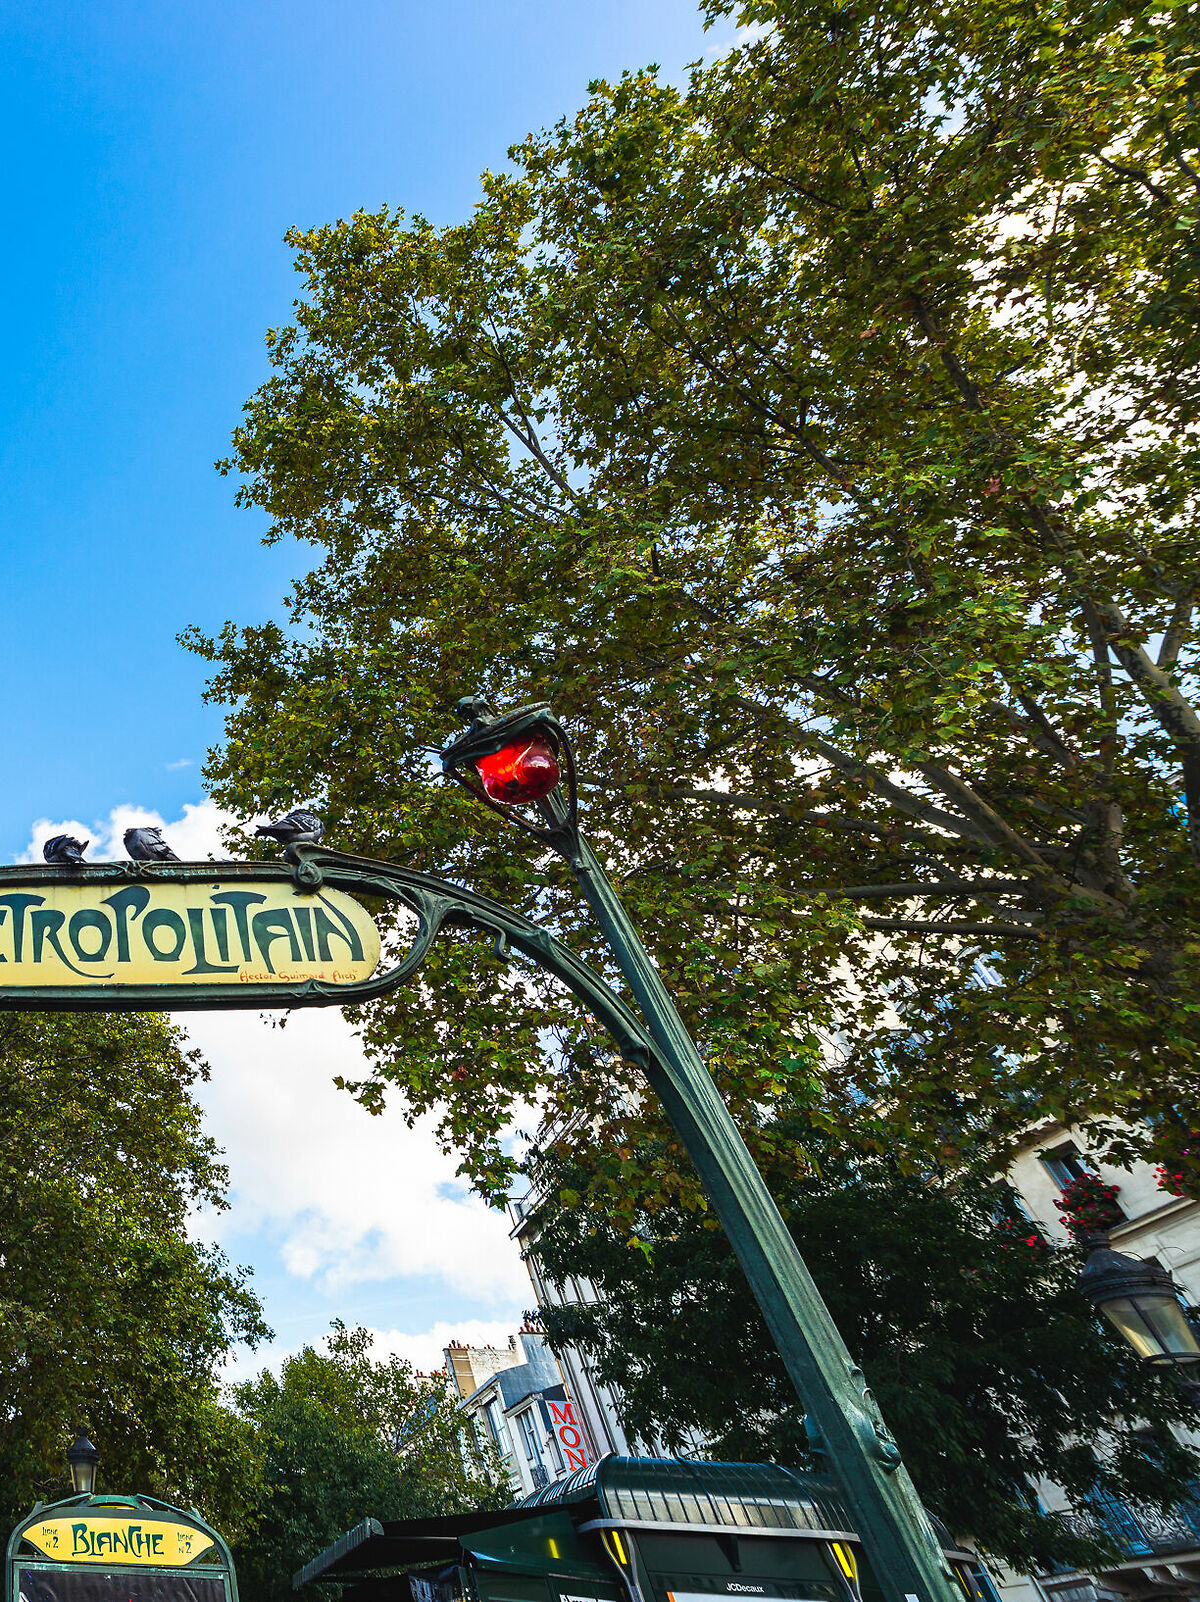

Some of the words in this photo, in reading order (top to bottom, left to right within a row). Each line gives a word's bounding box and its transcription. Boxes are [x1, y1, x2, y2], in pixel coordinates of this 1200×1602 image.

[548, 1403, 587, 1471] MON
[71, 1523, 165, 1558] BLANCHE
[726, 1582, 765, 1594] JCDecaux
